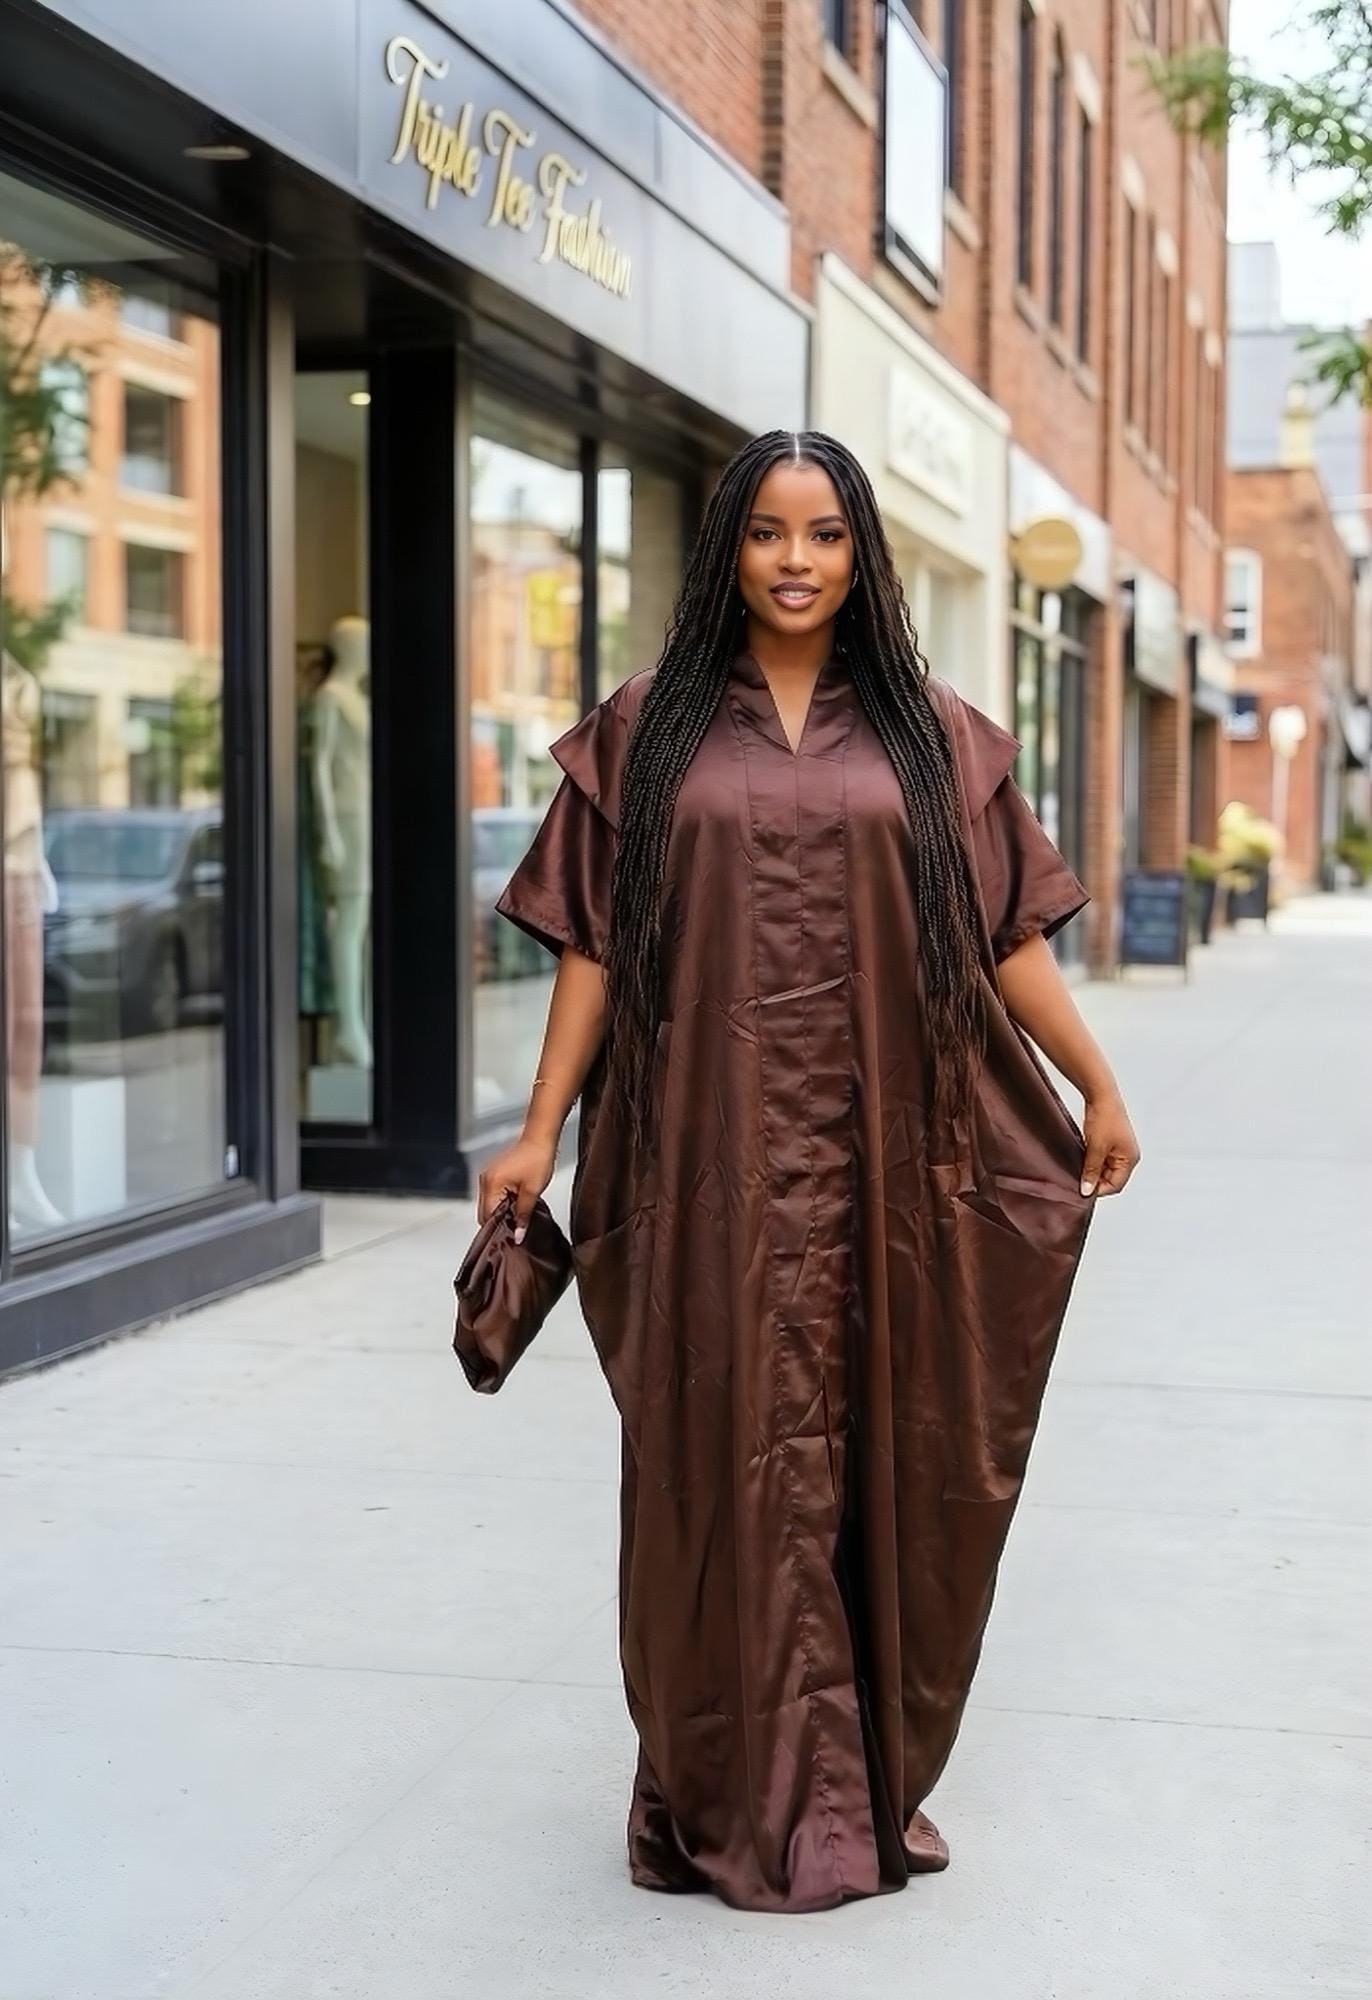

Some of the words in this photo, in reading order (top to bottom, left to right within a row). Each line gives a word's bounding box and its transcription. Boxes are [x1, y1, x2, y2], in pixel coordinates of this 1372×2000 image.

[386, 36, 481, 209] Triple
[484, 109, 535, 232] Tee
[537, 153, 631, 297] Fashion
